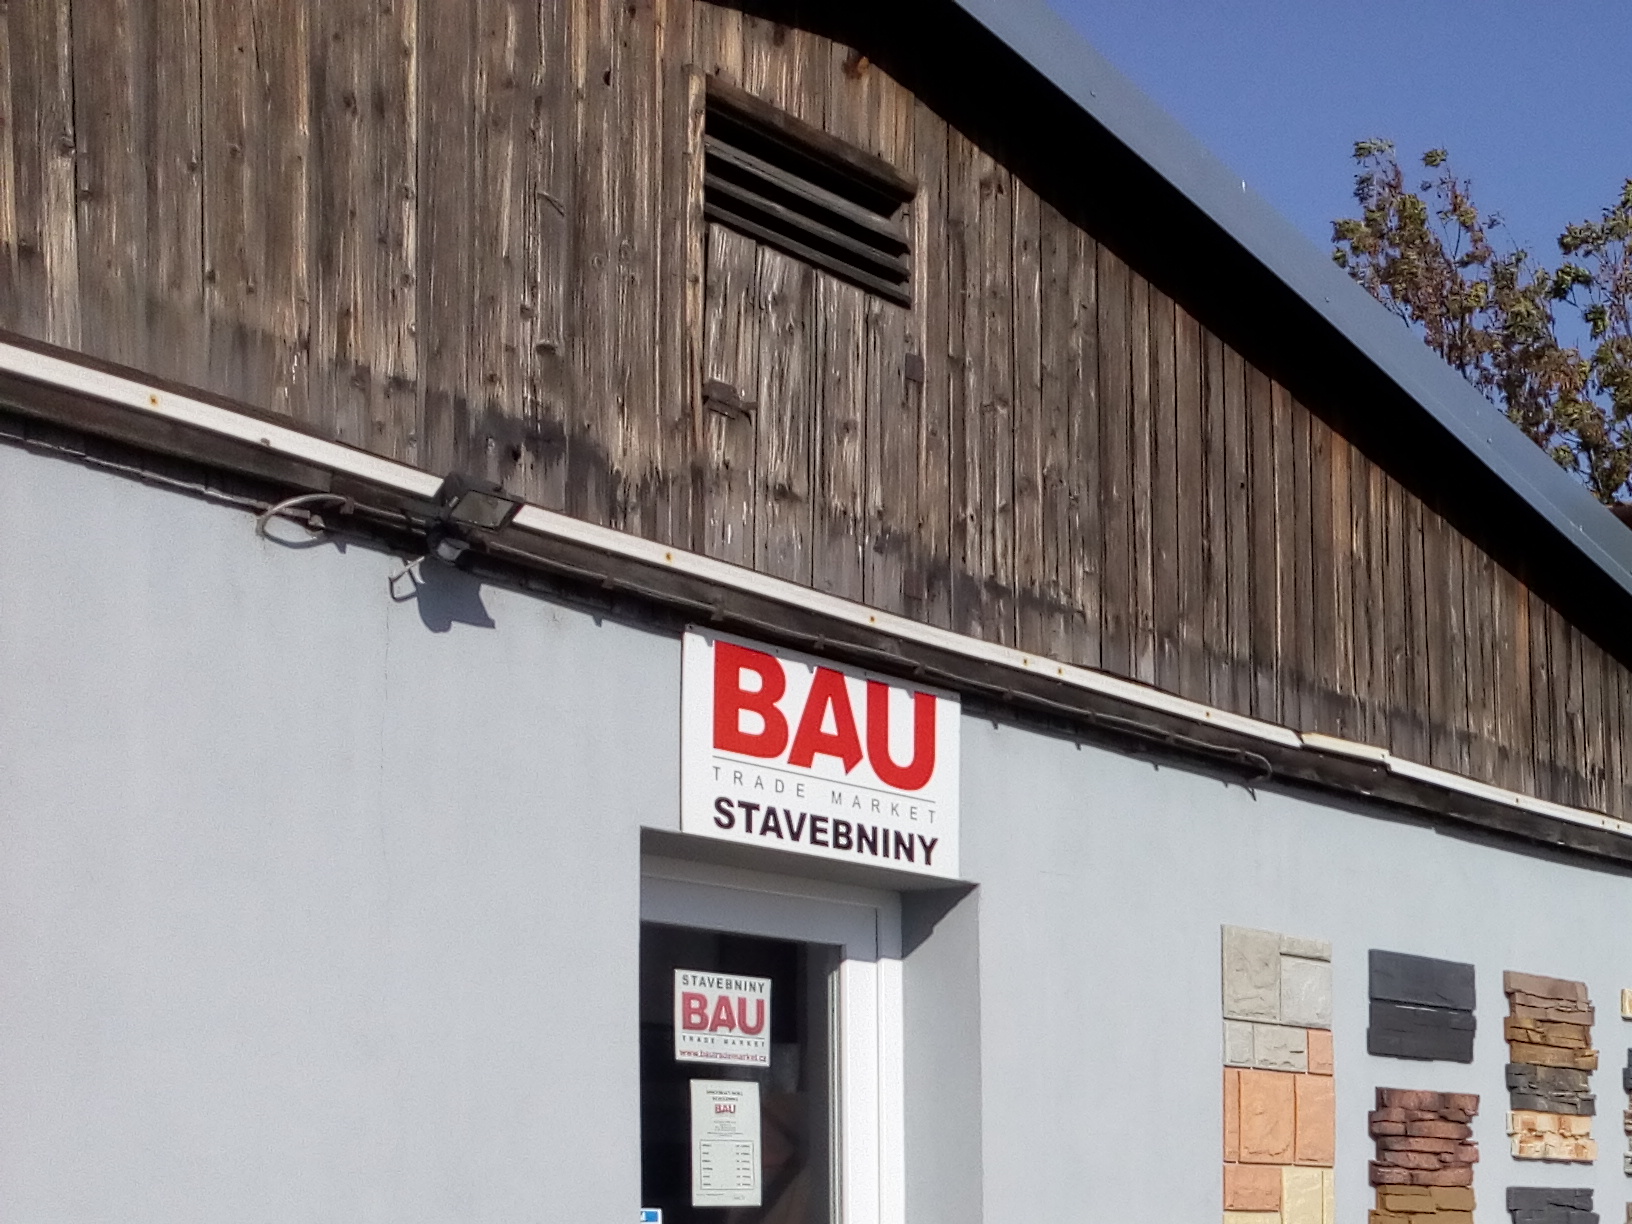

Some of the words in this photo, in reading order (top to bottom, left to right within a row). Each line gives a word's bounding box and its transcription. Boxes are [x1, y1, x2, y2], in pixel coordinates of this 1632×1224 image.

[713, 640, 938, 791] BAU
[712, 766, 806, 798] TRADE
[831, 791, 937, 824] MARKET
[713, 797, 939, 866] STAVEBNINY
[682, 974, 765, 993] STAVEBNINY
[682, 991, 765, 1036] BAU
